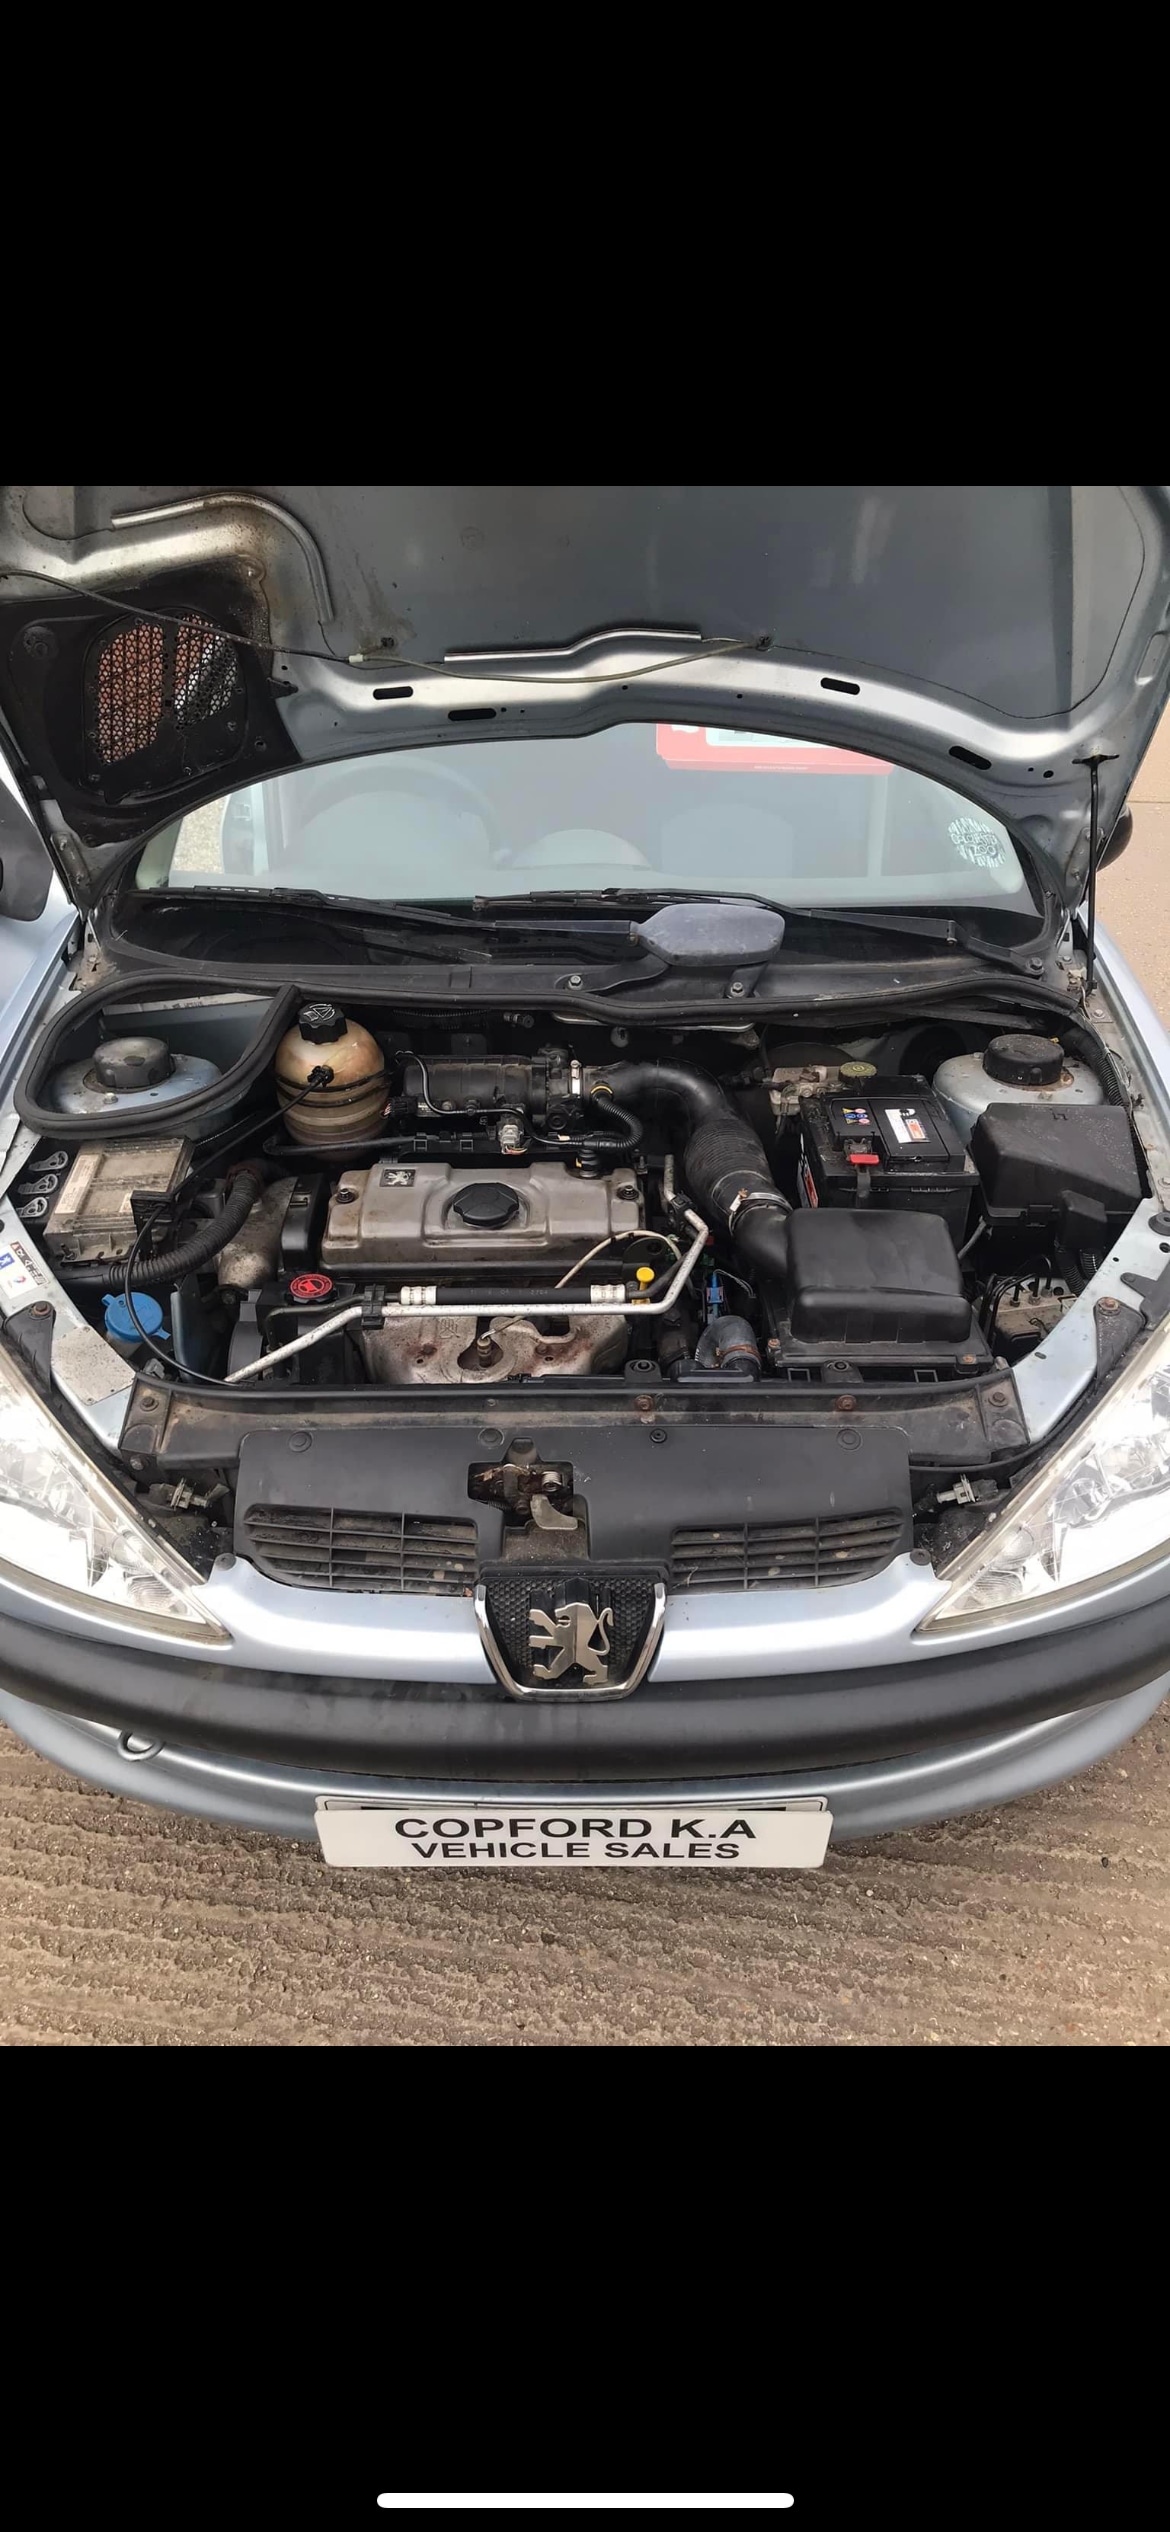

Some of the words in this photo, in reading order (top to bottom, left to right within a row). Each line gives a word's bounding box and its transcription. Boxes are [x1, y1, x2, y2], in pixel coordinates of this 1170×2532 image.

[969, 844, 996, 856] ZOO
[395, 1818, 652, 1838] COPFORD
[671, 1819, 756, 1839] K.A
[411, 1842, 590, 1858] VEHICLE
[604, 1842, 740, 1859] SALES
